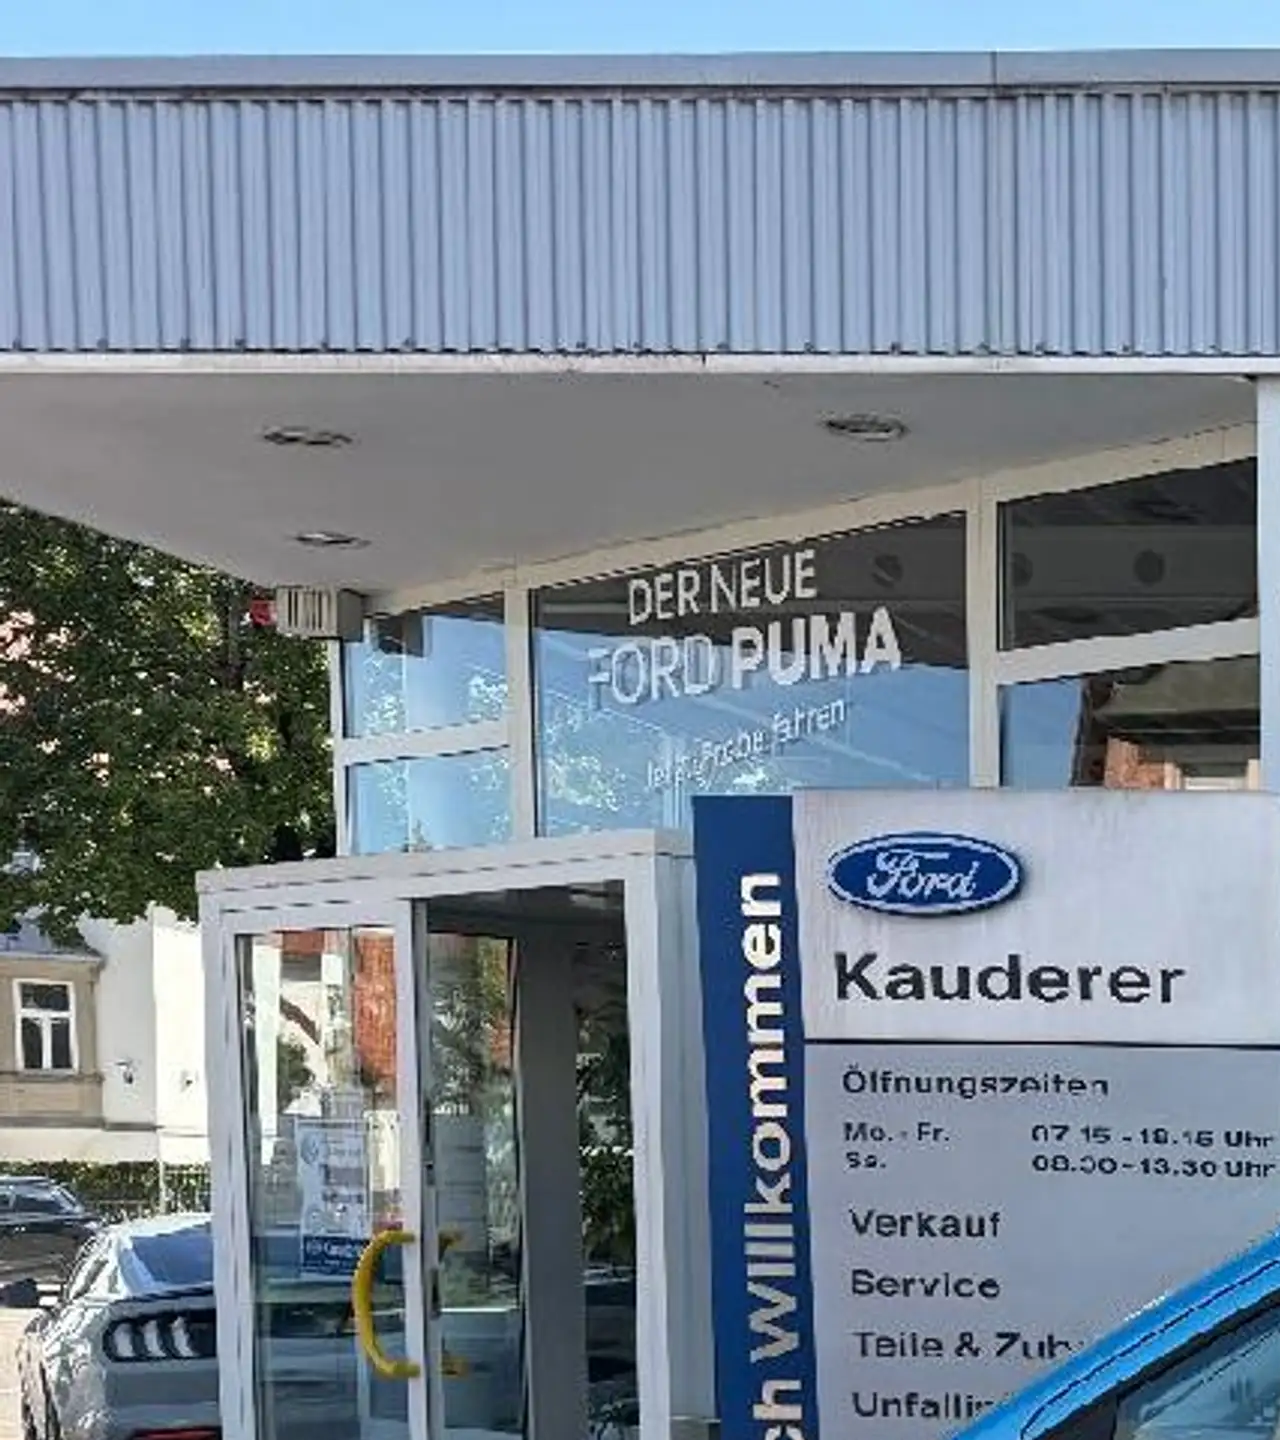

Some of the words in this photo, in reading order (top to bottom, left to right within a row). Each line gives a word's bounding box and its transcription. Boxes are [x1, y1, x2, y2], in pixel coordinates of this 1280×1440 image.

[628, 569, 700, 626] DER
[709, 549, 818, 614] NEUE
[587, 633, 717, 706] FORD
[731, 605, 902, 690] PUMA
[865, 848, 980, 900] Ford
[833, 952, 1185, 1003] Kauderer
[741, 871, 801, 1364] Willkommen
[843, 1121, 893, 1142] Mo.
[917, 1121, 950, 1142] Fr.
[1223, 1130, 1275, 1149] Uhr
[845, 1151, 887, 1169] Sa.
[1223, 1160, 1276, 1178] Uhr
[849, 1208, 1001, 1238] Verkauf
[851, 1268, 1000, 1299] Service
[852, 1331, 943, 1358] Teile
[954, 1331, 981, 1357] &
[995, 1331, 1084, 1360] Zub
